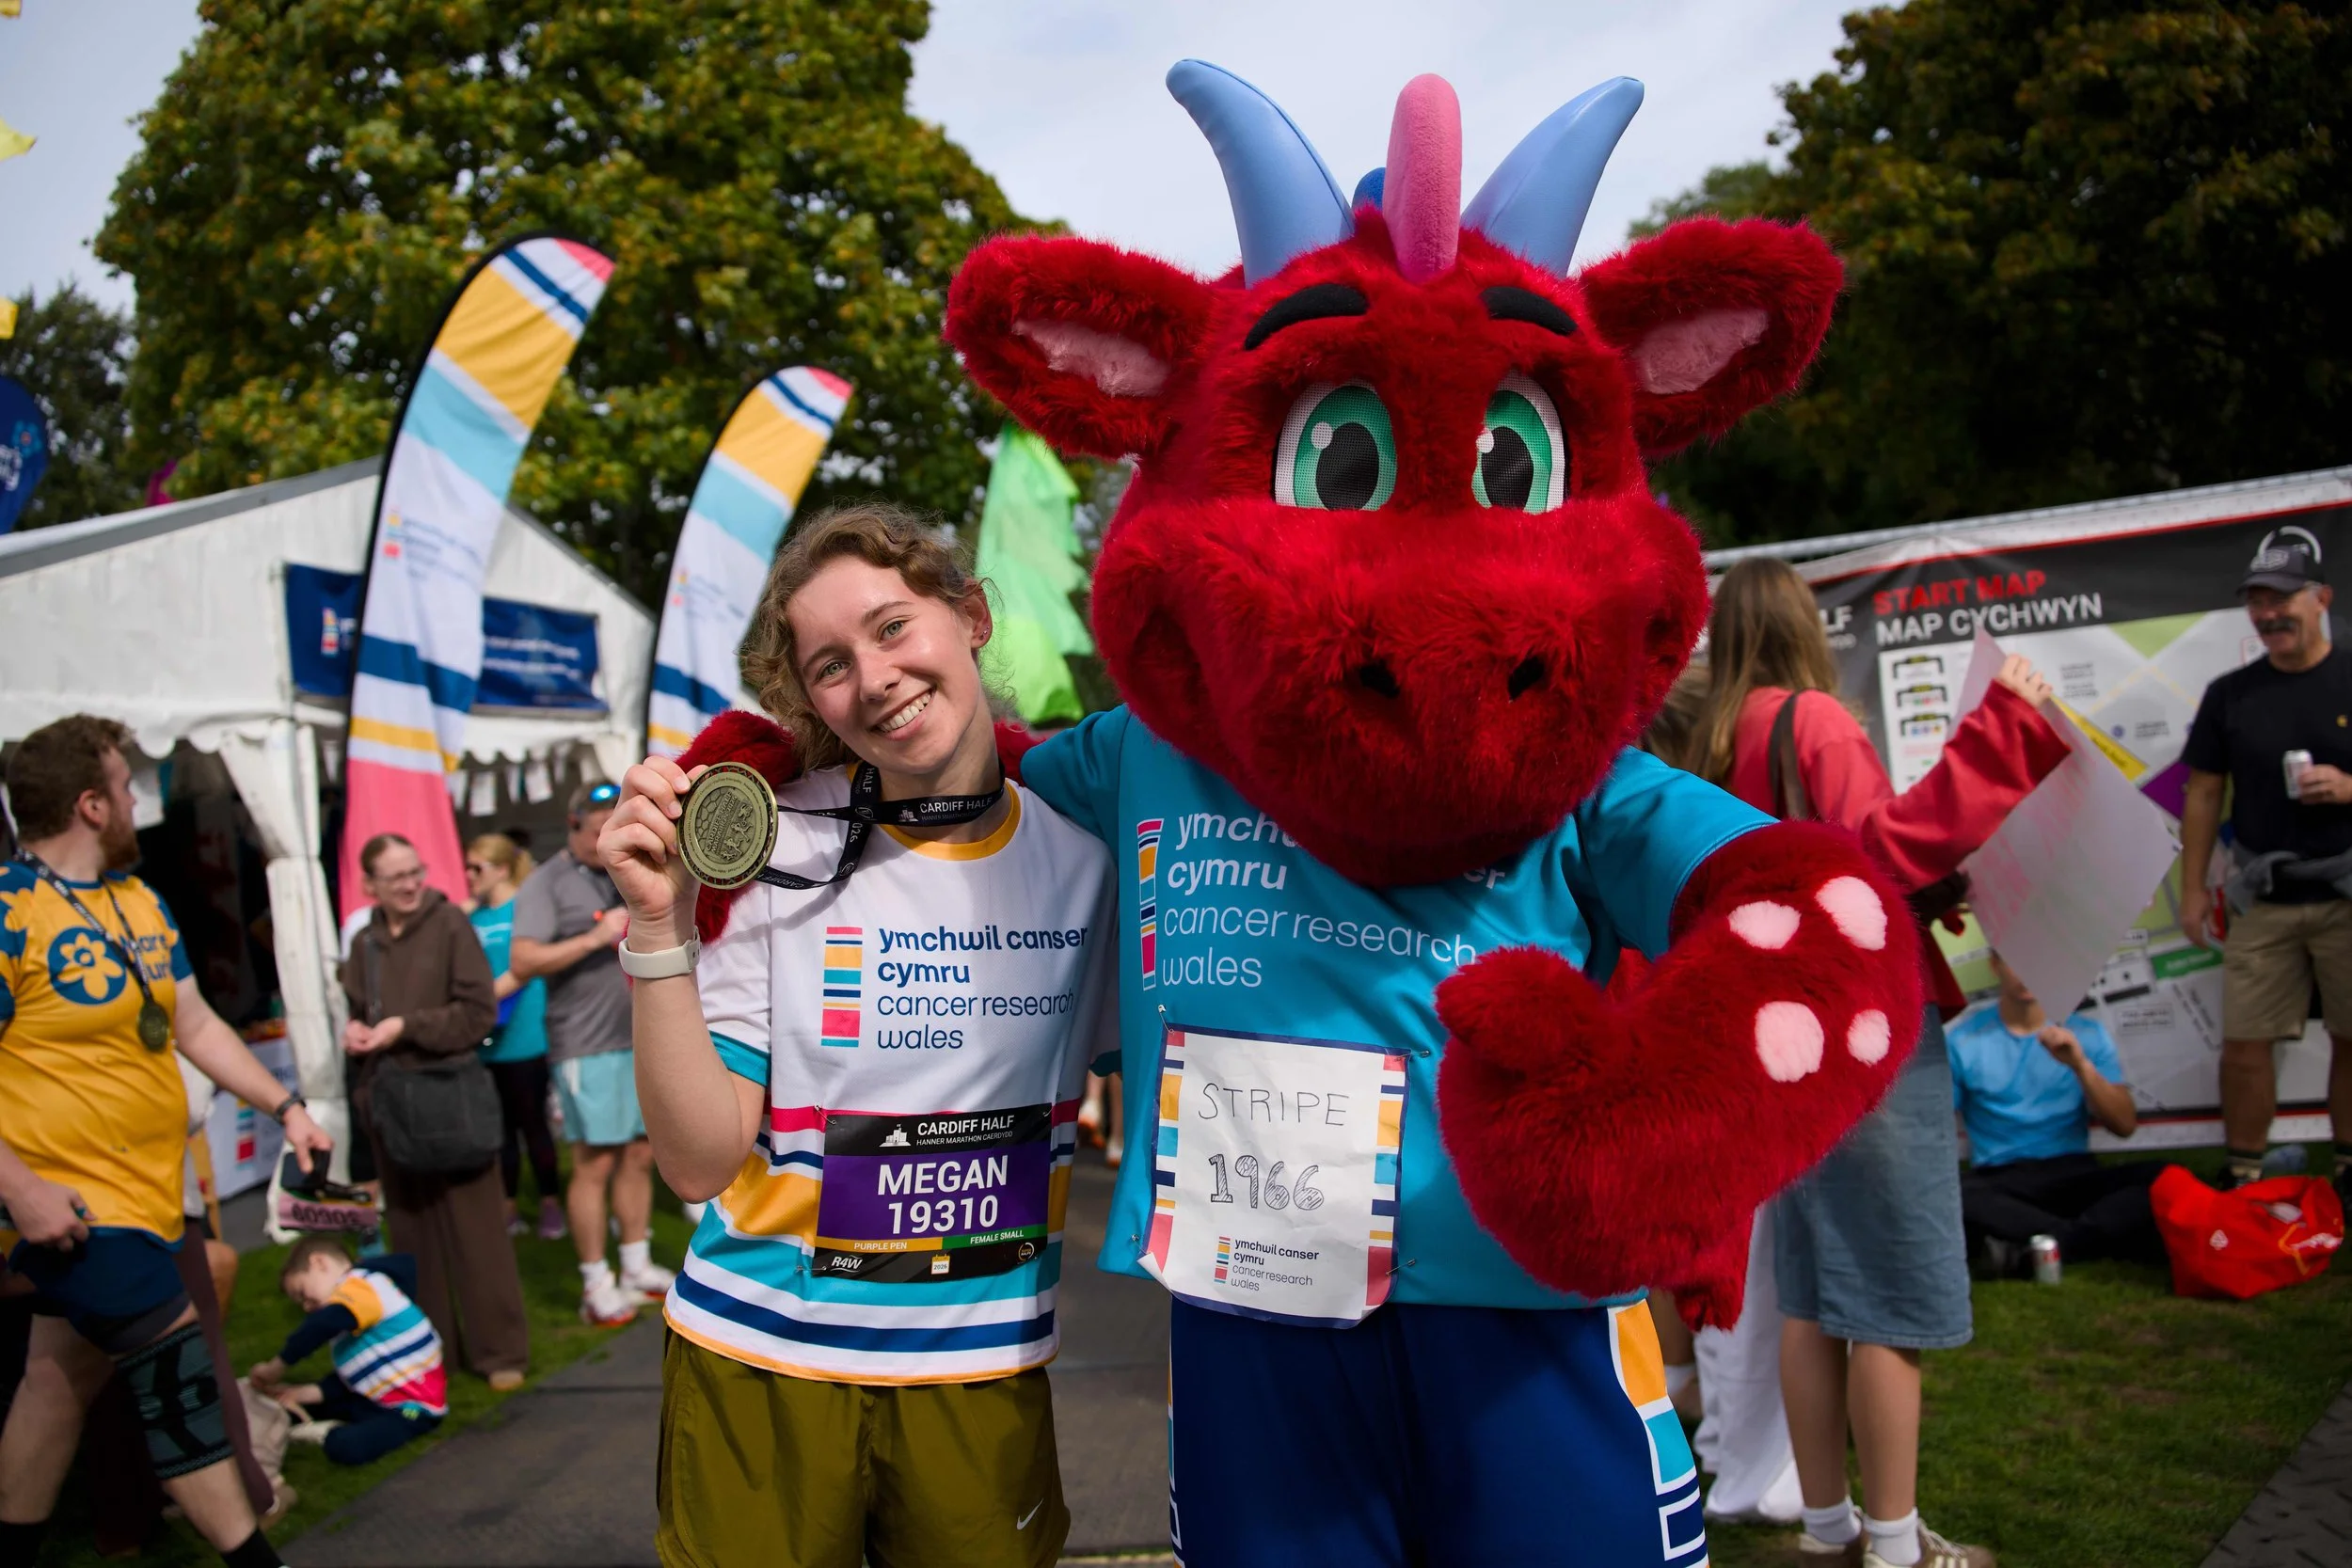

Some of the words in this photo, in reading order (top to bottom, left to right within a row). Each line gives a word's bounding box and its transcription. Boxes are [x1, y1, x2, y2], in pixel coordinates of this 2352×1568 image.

[1871, 578, 1970, 615] START
[1977, 570, 2046, 601] MAP
[1820, 605, 1852, 633] LF
[1876, 612, 1944, 645] MAP
[1949, 593, 2103, 636] CYCHWYN
[862, 767, 875, 793] HALF
[920, 800, 964, 814] CARDIFF
[966, 797, 993, 810] HALF
[850, 822, 863, 843] 026
[1167, 858, 1287, 896] cymru
[879, 926, 1002, 954] ymchwil
[1007, 927, 1088, 950] canser
[1164, 906, 1288, 938] cancer
[1293, 912, 1476, 968] research
[878, 961, 970, 988] cymru
[1162, 946, 1263, 988] wales
[878, 995, 977, 1016] cancer
[983, 988, 1073, 1016] research
[878, 1024, 963, 1049] wales
[1198, 1083, 1350, 1127] STRIPE
[916, 1137, 945, 1146] HANNER
[946, 1134, 982, 1145] MARATHON
[982, 1131, 1013, 1141] CAERDYDD
[917, 1118, 978, 1136] CARDIFF
[981, 1115, 1015, 1132] HALF
[877, 1154, 1009, 1196] MEGAN
[1208, 1153, 1325, 1211] 1966
[888, 1195, 998, 1234] 19310
[853, 1242, 888, 1250] PURPLE
[890, 1242, 908, 1250] PEN
[970, 1233, 999, 1244] FEMALE
[1000, 1229, 1025, 1240] SMALL
[1234, 1239, 1278, 1255] ymchwil
[1279, 1247, 1319, 1260] canser
[832, 1254, 863, 1270] R4W
[1233, 1252, 1264, 1265] cymru
[1231, 1277, 1260, 1291] wales
[1232, 1264, 1265, 1278] cancer
[1265, 1272, 1313, 1286] research
